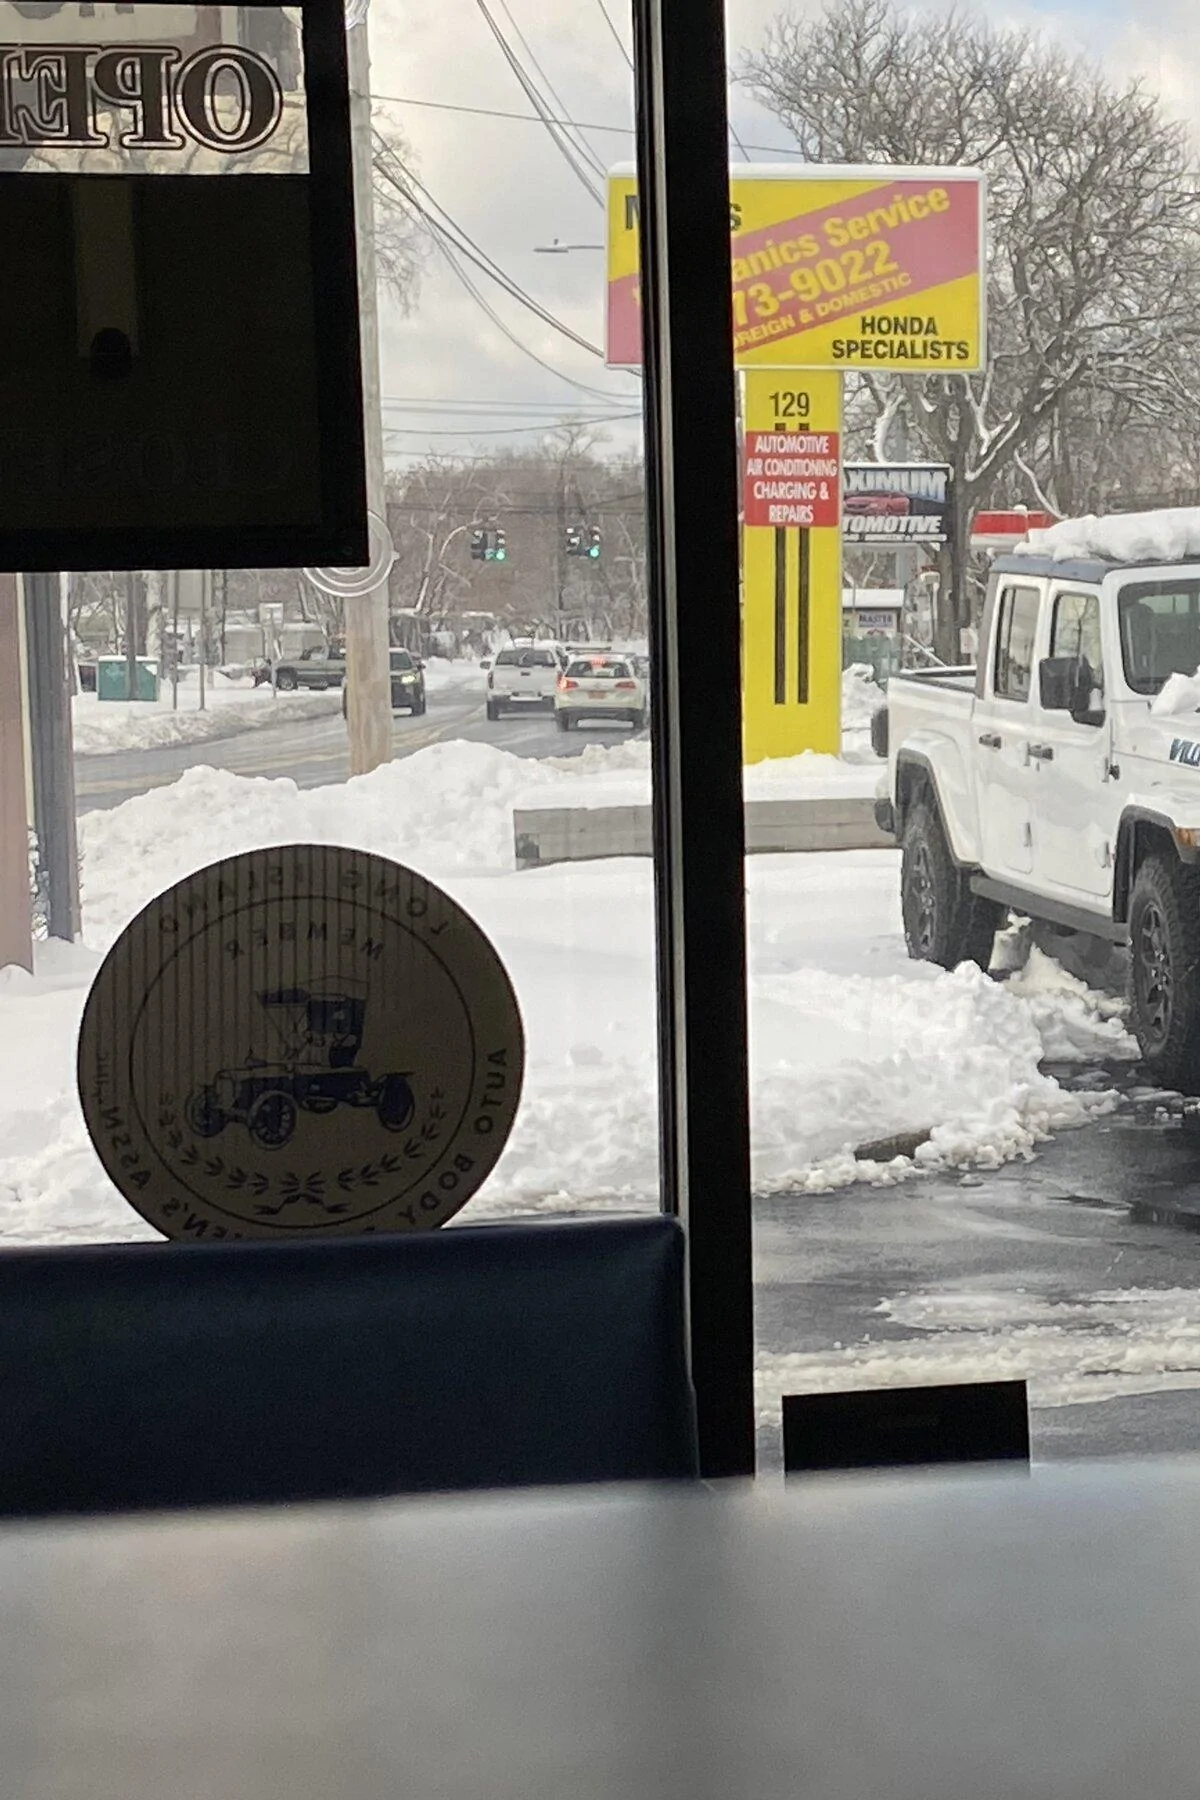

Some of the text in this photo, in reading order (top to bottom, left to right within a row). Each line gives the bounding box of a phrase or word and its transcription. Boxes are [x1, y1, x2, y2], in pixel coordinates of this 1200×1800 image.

[733, 188, 951, 283] anics Service
[732, 240, 899, 327] 73-9022
[733, 272, 912, 349] REIGN & DOMESTIC
[861, 316, 939, 336] HONDA
[831, 340, 970, 360] SPECIALISTS
[768, 391, 810, 417] 129
[754, 435, 830, 454] AUTOMOTIVE
[746, 458, 838, 476] AIR CONDITIONING
[753, 481, 830, 500] CHARGING &
[768, 504, 815, 524] REPAIRS
[842, 515, 943, 533] TOMOTIVE
